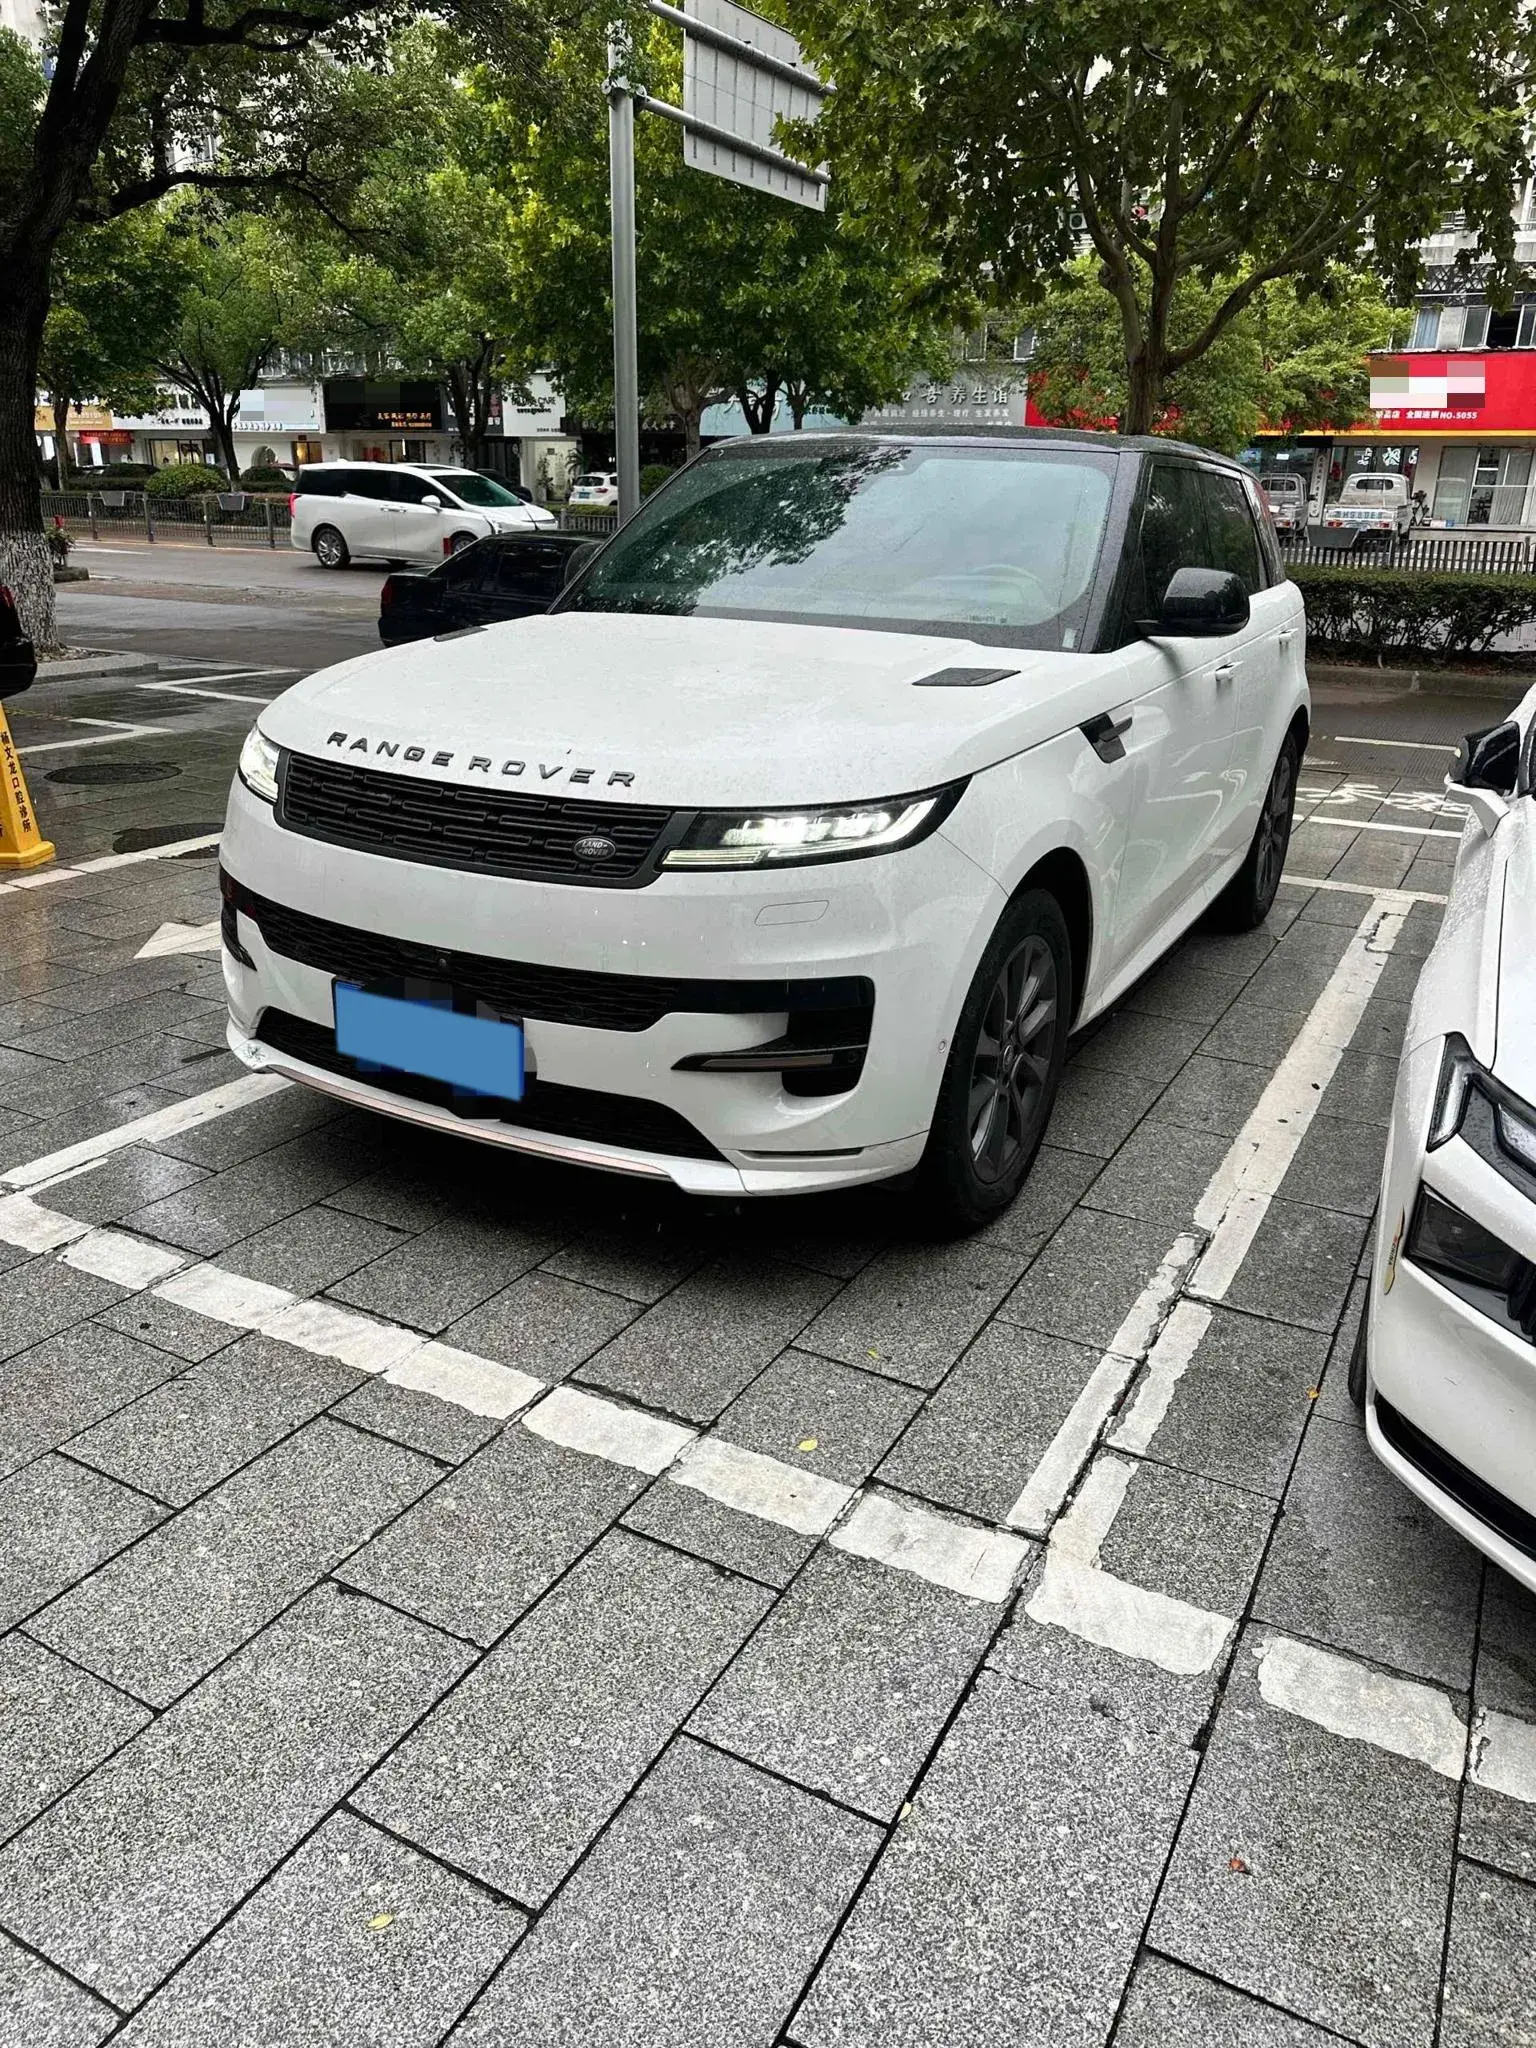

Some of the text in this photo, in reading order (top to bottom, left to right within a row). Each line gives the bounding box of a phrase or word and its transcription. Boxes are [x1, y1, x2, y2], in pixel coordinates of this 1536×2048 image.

[0, 731, 32, 833] 杨文龙口腔诊所
[327, 731, 635, 787] RANGE ROVER
